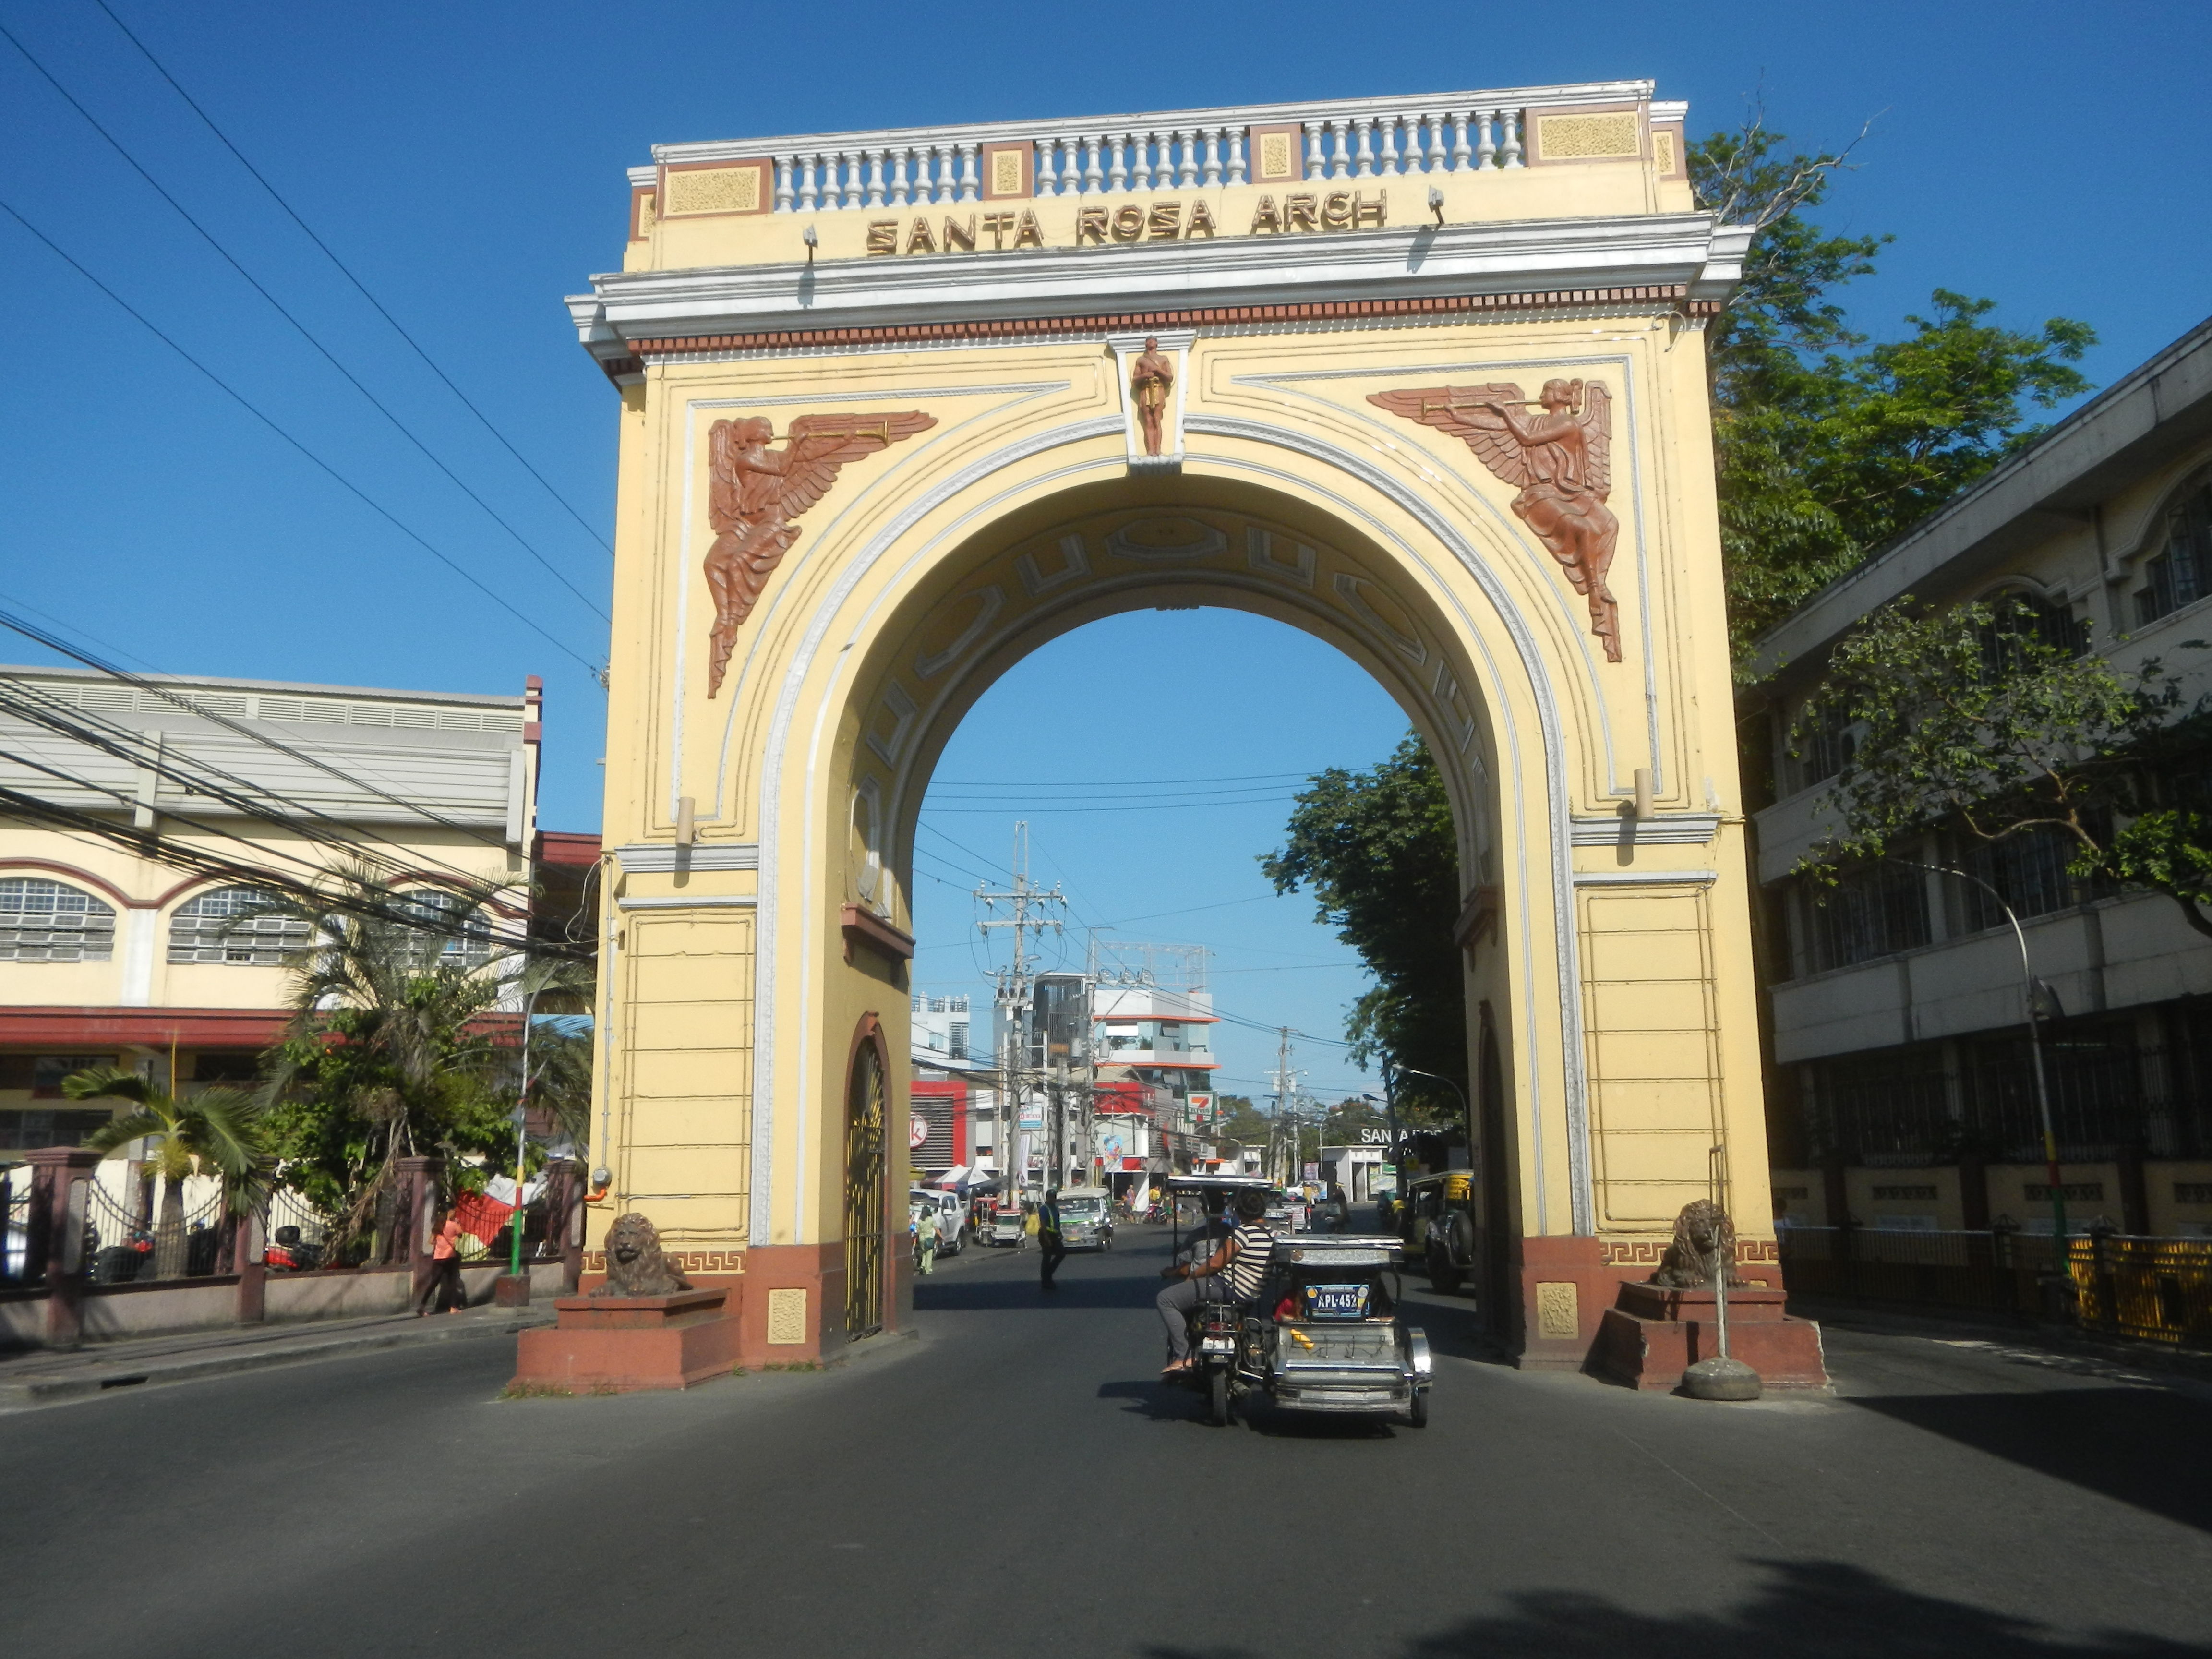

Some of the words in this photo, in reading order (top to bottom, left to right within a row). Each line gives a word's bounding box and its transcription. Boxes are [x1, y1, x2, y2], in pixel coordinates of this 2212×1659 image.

[867, 209, 1044, 251] SANTA
[1078, 199, 1216, 238] ROSA
[1251, 189, 1387, 227] ARCH
[1361, 1128, 1408, 1143] SANA
